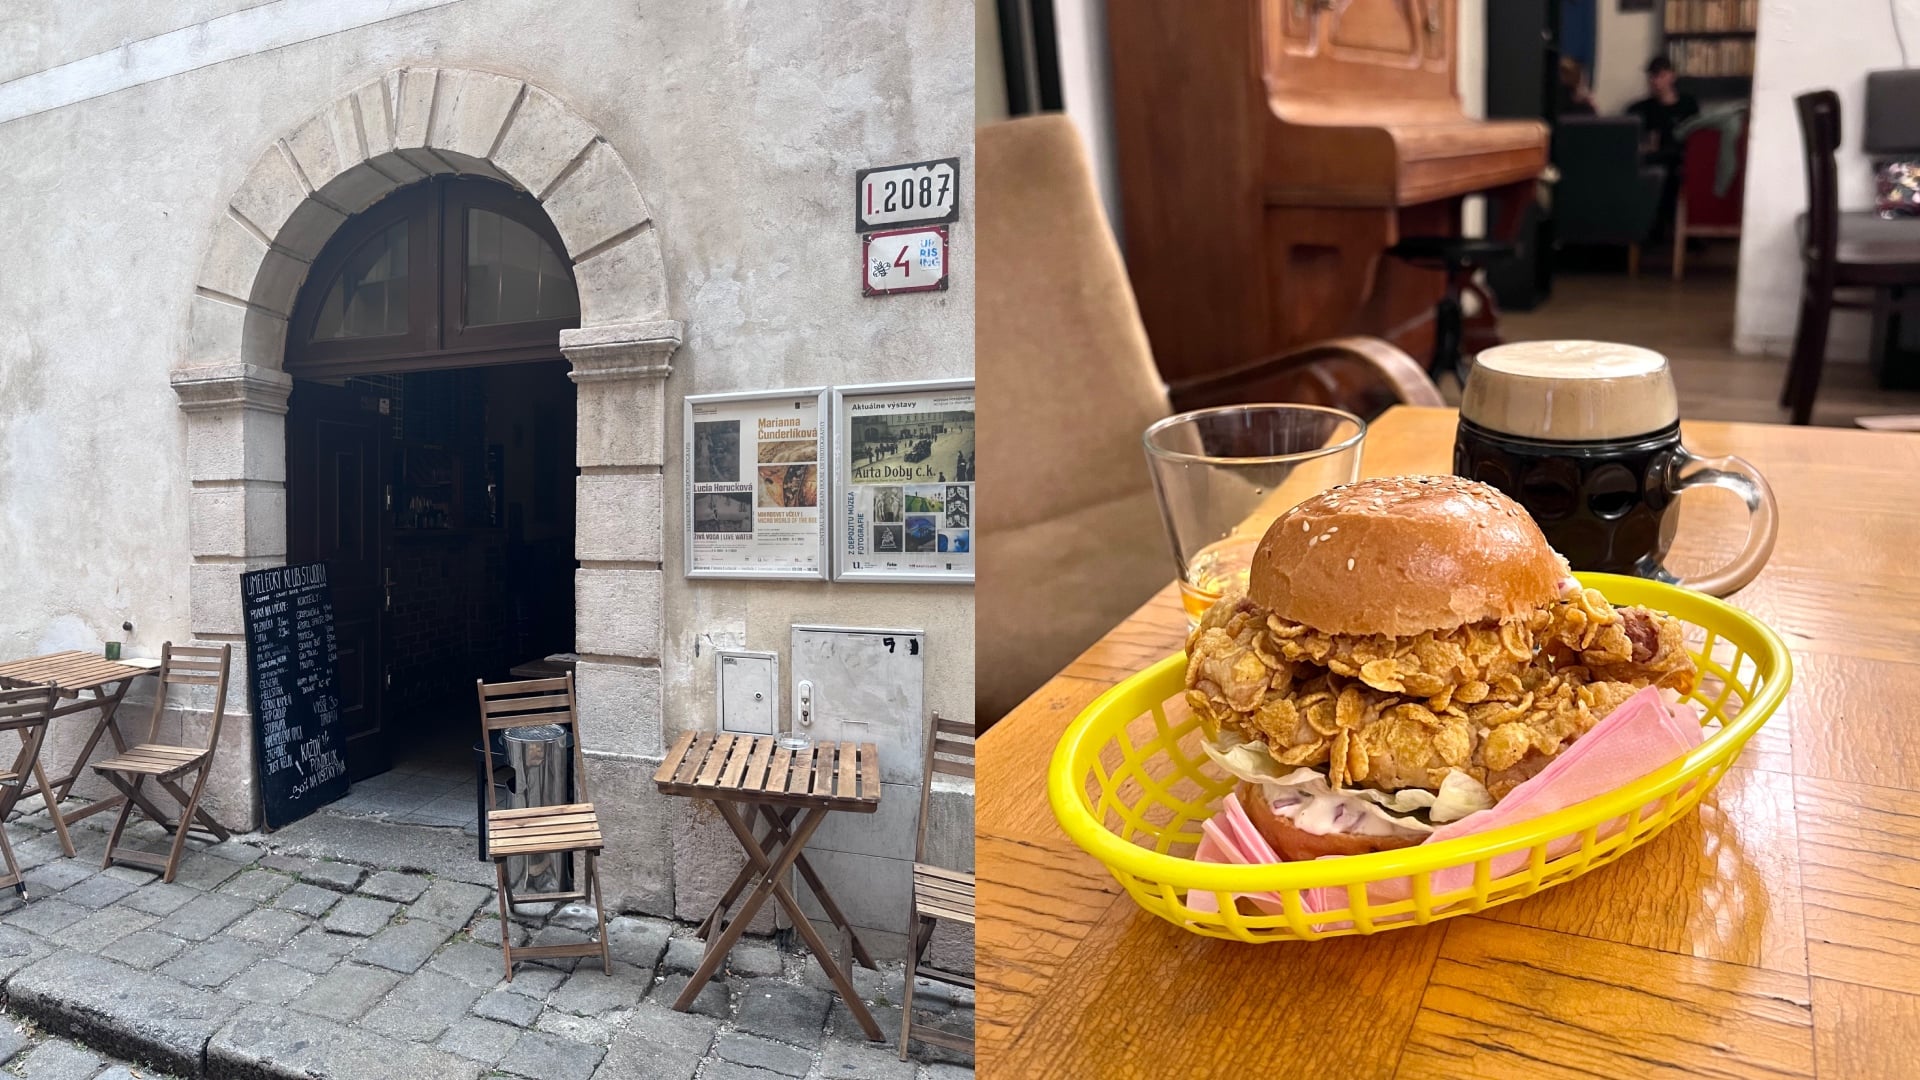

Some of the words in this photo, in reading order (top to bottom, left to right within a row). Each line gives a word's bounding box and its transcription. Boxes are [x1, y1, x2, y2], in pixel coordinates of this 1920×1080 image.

[893, 245, 910, 277] 4
[851, 402, 885, 411] Aktuálne
[887, 401, 917, 411] výstavy
[758, 417, 801, 428] Marianna
[855, 467, 881, 479] Auta
[884, 465, 913, 480] Doby
[694, 483, 713, 493] Lucia
[847, 516, 855, 549] DEPOZITU
[857, 513, 865, 555] FOTOGRAFIE
[284, 567, 301, 589] KLUB
